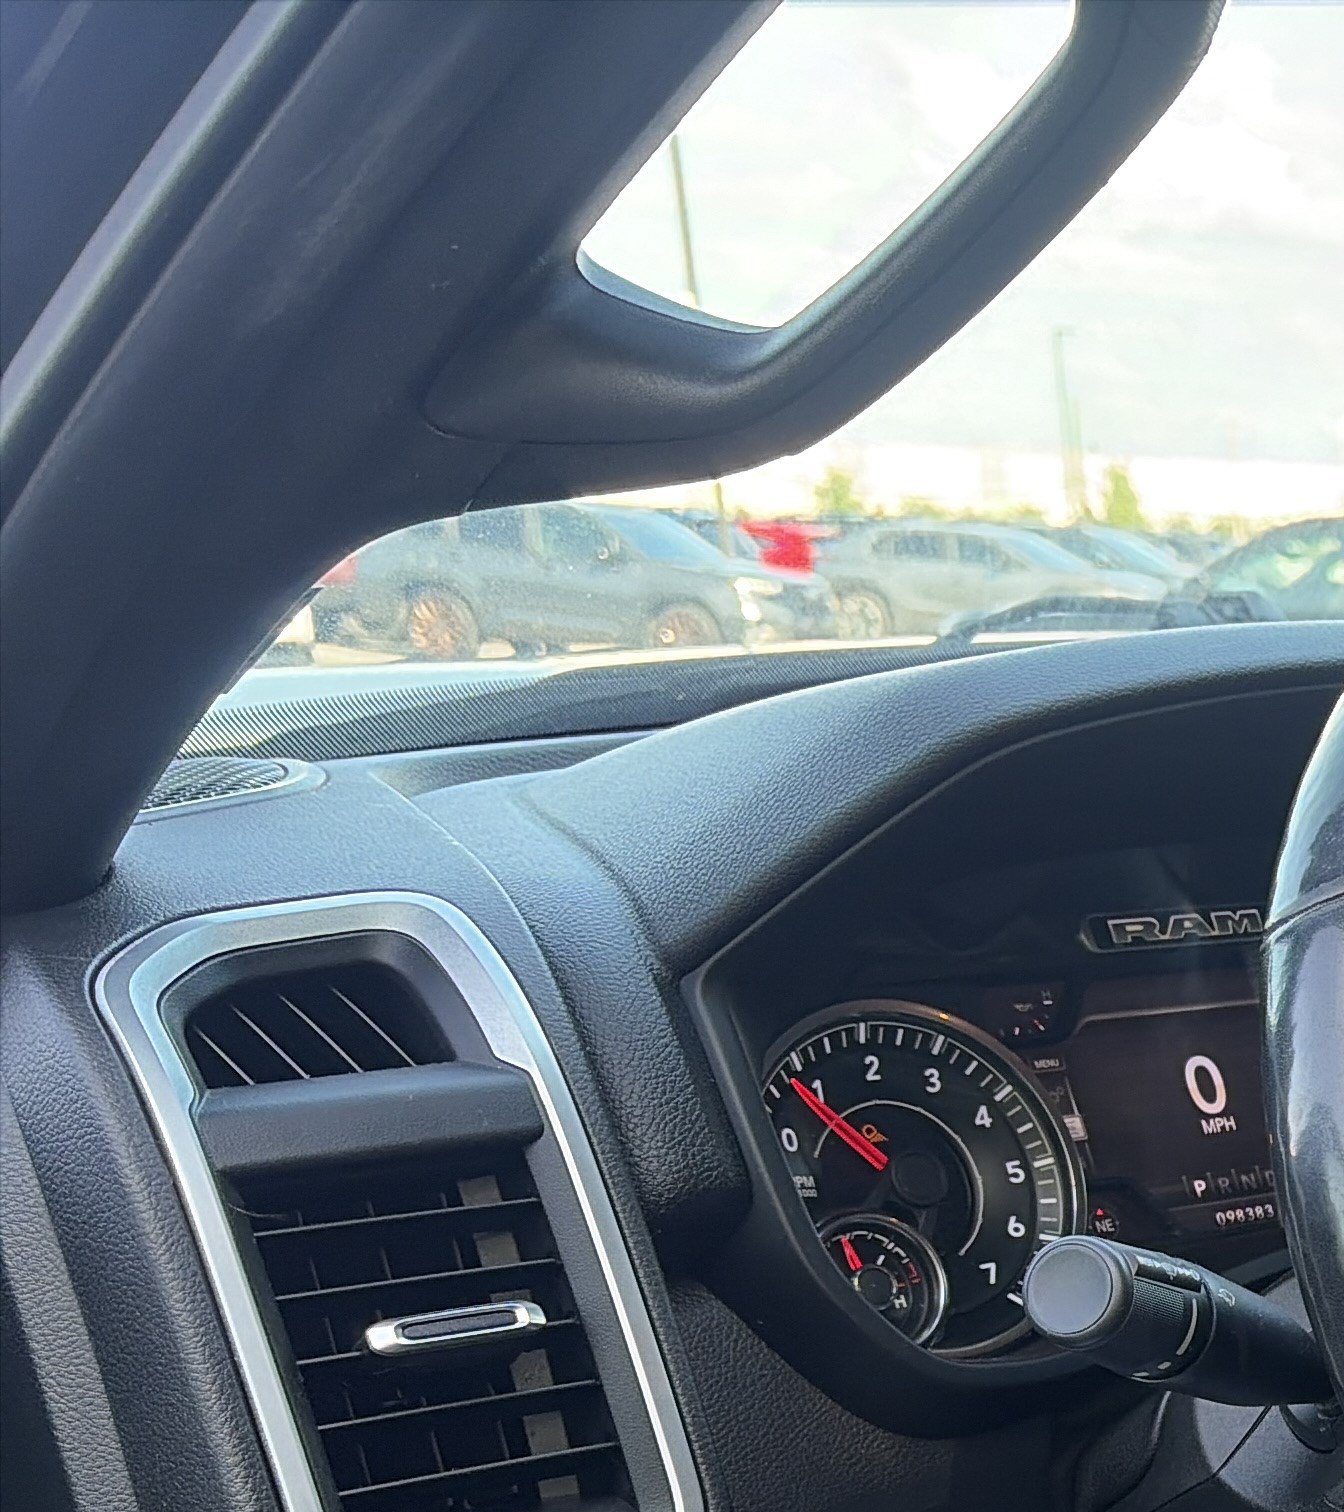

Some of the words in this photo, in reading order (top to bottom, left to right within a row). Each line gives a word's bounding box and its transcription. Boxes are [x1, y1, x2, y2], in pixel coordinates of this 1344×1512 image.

[1107, 909, 1264, 944] RAM
[863, 1055, 882, 1081] 2
[1033, 1058, 1060, 1070] MENU
[811, 1079, 824, 1103] 1
[923, 1068, 942, 1093] 3
[1185, 1055, 1227, 1115] 0
[974, 1105, 993, 1128] 4
[1201, 1116, 1237, 1135] MPH
[781, 1128, 799, 1152] 0
[1005, 1160, 1026, 1184] 5
[1193, 1179, 1207, 1198] P
[1218, 1177, 1232, 1194] R
[1240, 1173, 1257, 1190] N
[1007, 1215, 1026, 1238] 6
[1095, 1218, 1117, 1233] NE
[1215, 1203, 1275, 1226] 098383
[979, 1262, 997, 1285] 7
